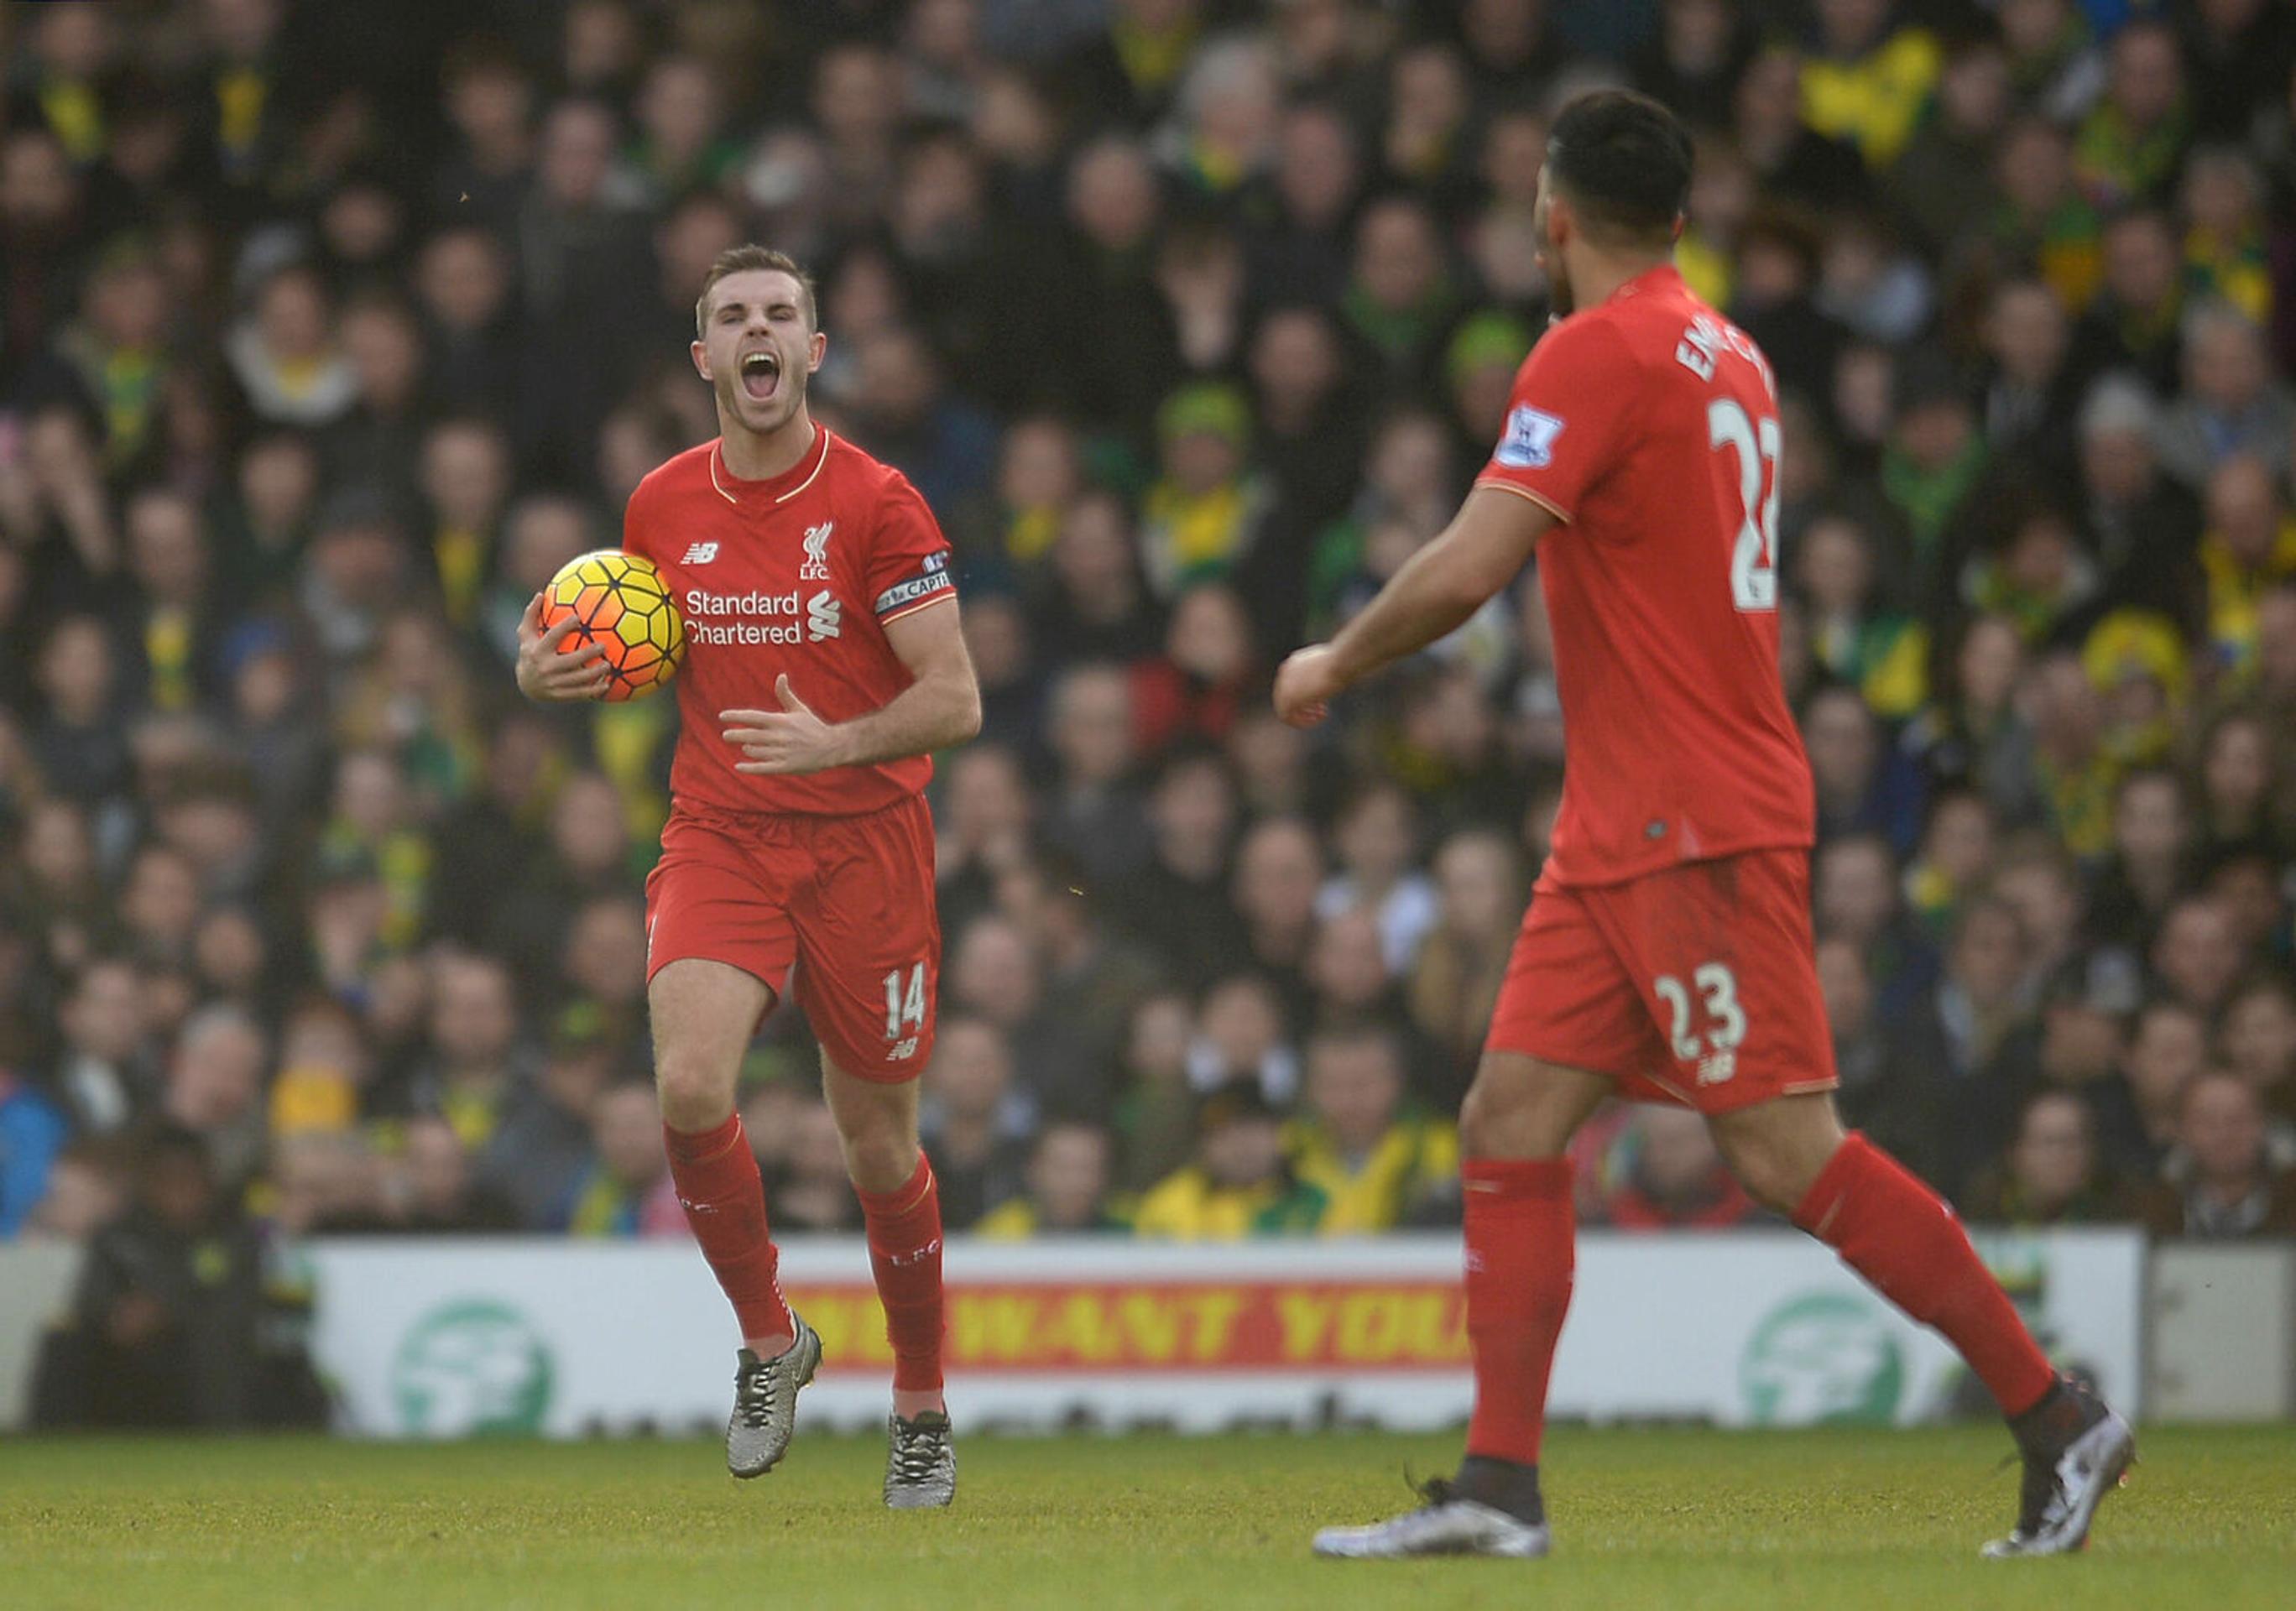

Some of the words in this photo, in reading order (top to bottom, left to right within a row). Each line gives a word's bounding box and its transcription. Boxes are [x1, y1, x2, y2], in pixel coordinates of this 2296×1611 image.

[684, 619, 802, 645] Chartered
[686, 590, 799, 616] Standard
[883, 961, 925, 1039] 14
[1654, 962, 1747, 1061] 23
[950, 1292, 1244, 1363] WANT
